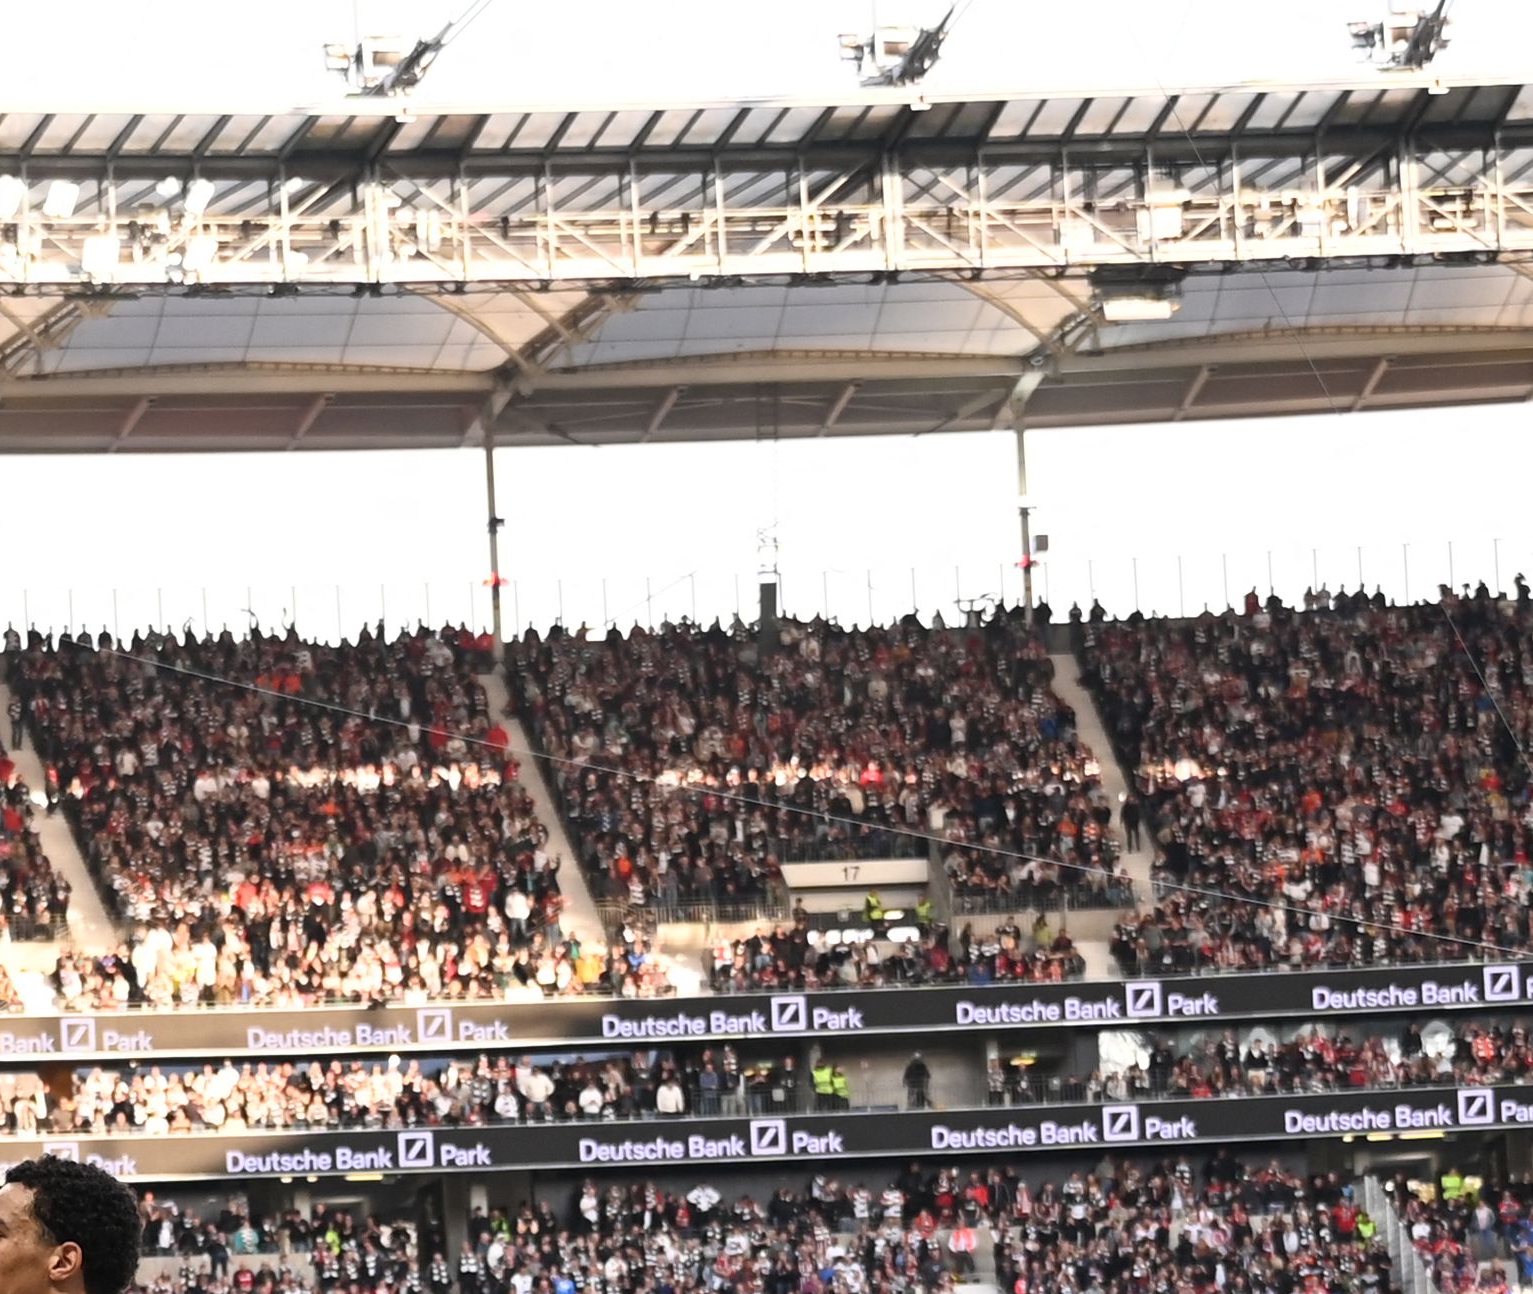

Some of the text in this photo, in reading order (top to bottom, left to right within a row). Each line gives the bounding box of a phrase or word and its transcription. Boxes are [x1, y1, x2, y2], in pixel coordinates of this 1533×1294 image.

[843, 866, 860, 882] 17
[956, 993, 1219, 1024] Deutsche Bank Park
[1312, 985, 1417, 1010] Deutsche
[1421, 982, 1478, 1006] Bank
[247, 1020, 509, 1049] Deutsche Bank Park
[602, 1007, 864, 1038] Deutsche Bank Park
[103, 1028, 153, 1051] Park
[930, 1116, 1196, 1149] Deutsche Bank Park
[1284, 1107, 1391, 1133] Deutsche
[1395, 1103, 1452, 1127] Bank
[226, 1143, 491, 1173] Deutsche Bank Park
[579, 1131, 843, 1162] Deutsche Bank Park
